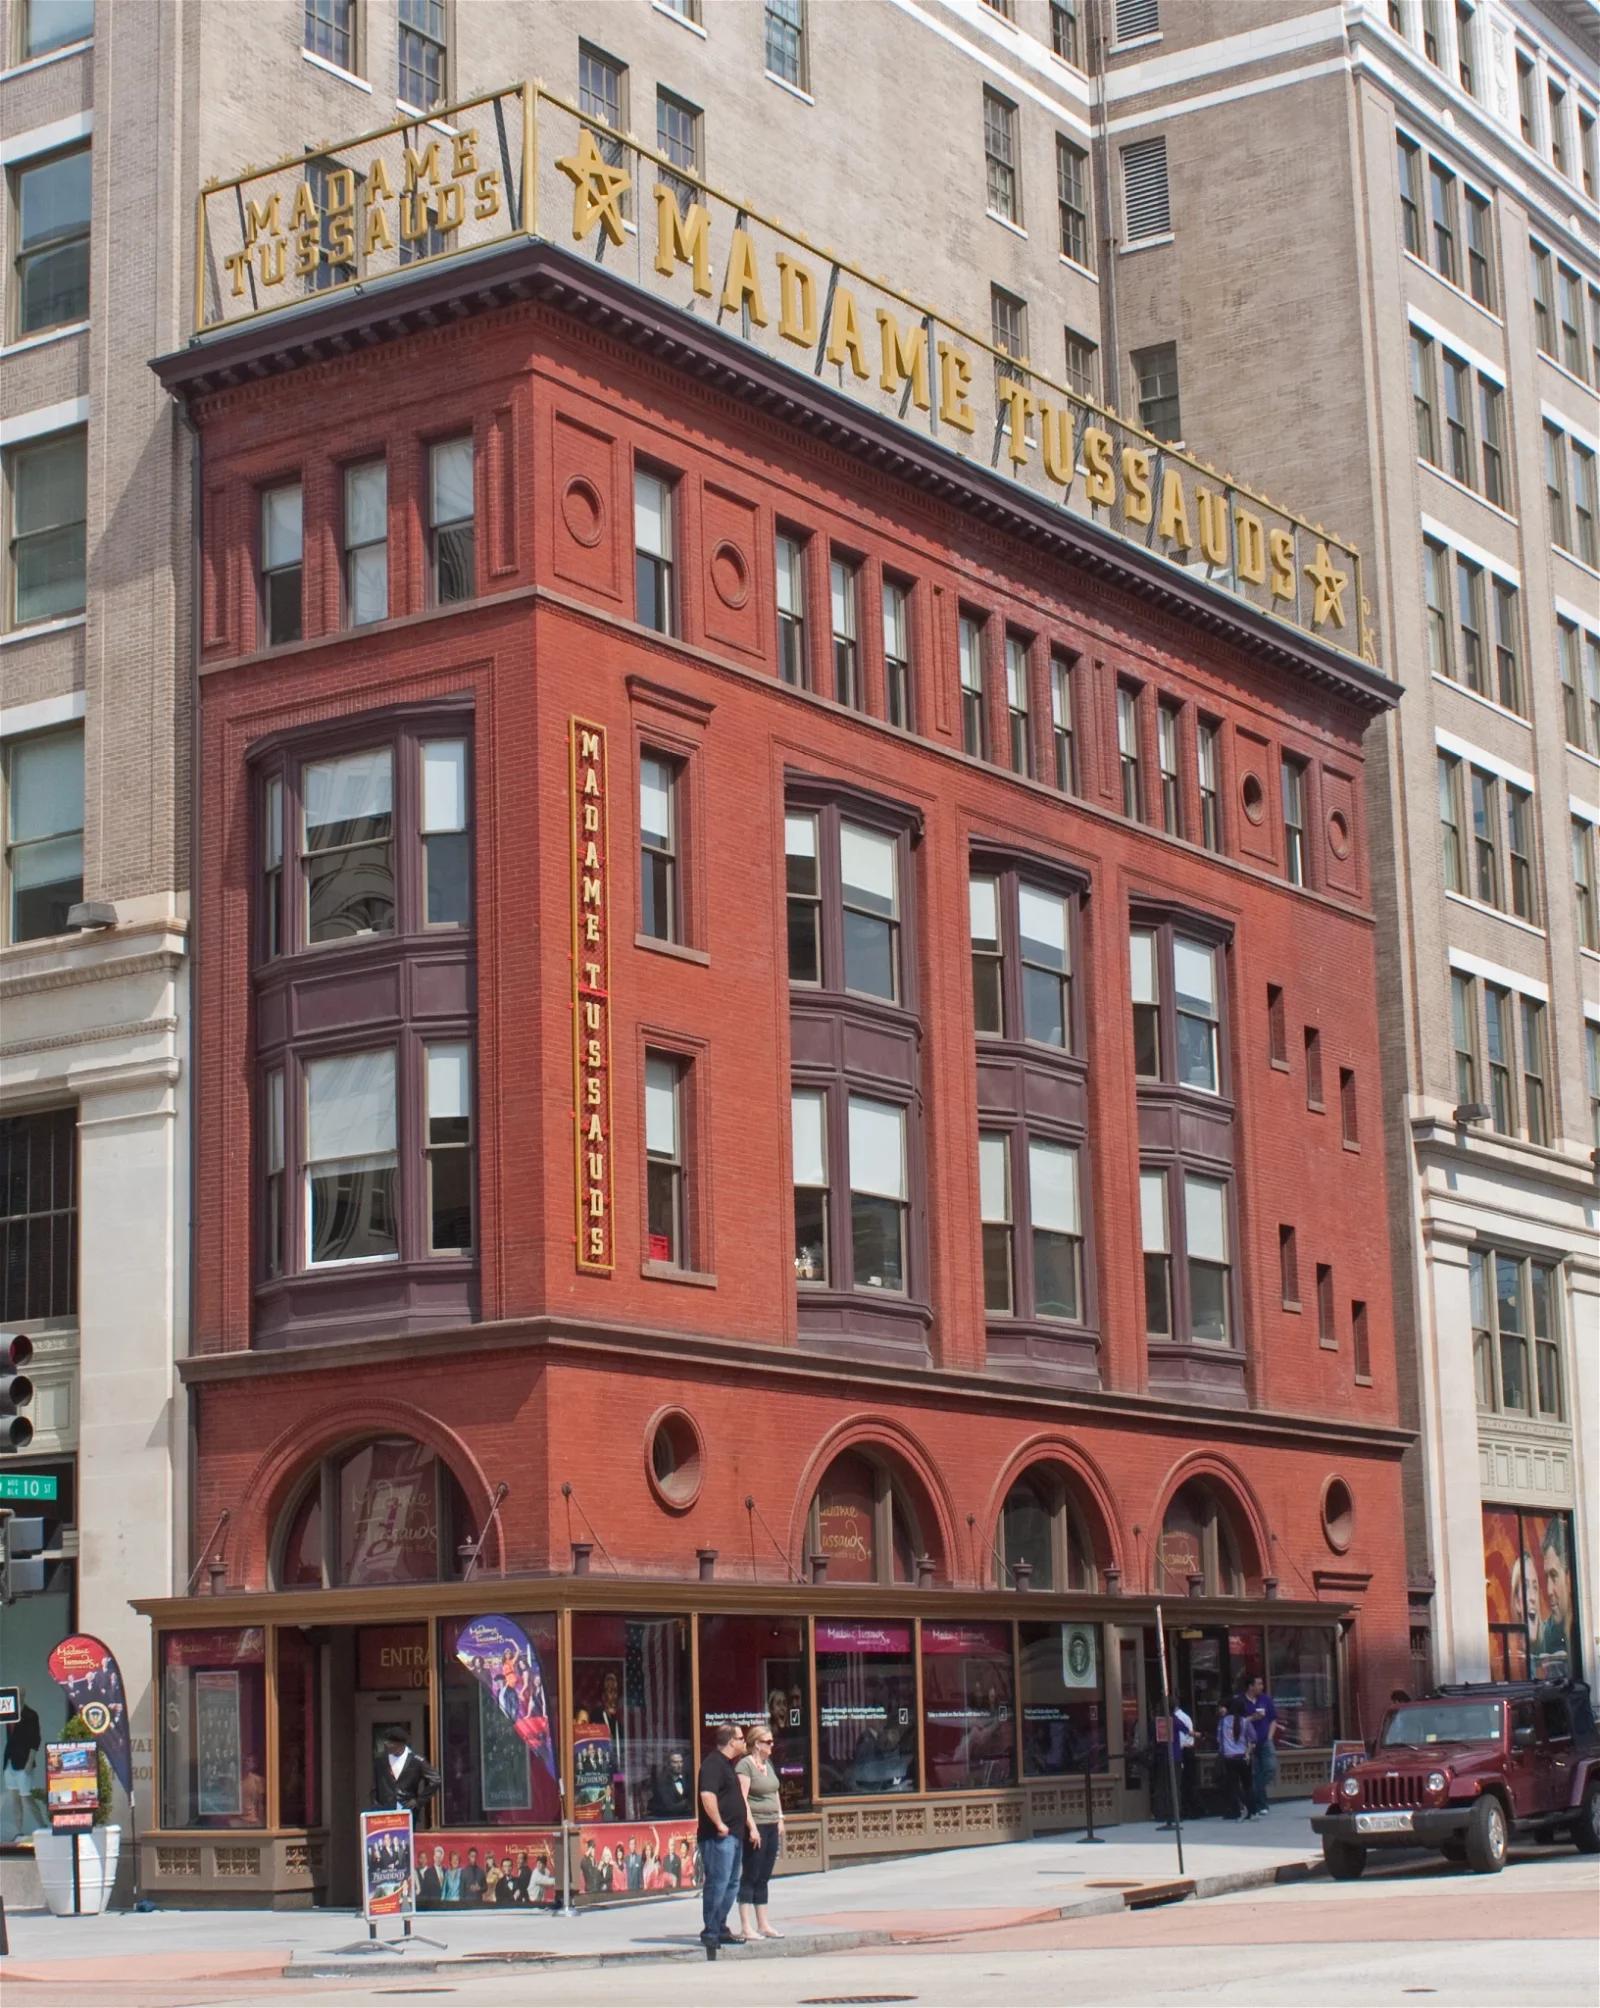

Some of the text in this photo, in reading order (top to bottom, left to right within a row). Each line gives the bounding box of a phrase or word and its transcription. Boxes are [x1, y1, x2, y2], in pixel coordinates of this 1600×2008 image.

[224, 169, 501, 297] TUSSAUDS
[245, 128, 479, 246] MADAME
[652, 183, 1297, 602] MADAME TUSSAUDS
[582, 730, 604, 1256] MADAME TUSSAUDS
[24, 1480, 51, 1496] 10 ST
[0, 1698, 12, 1711] AY
[380, 1646, 430, 1667] ENTRA
